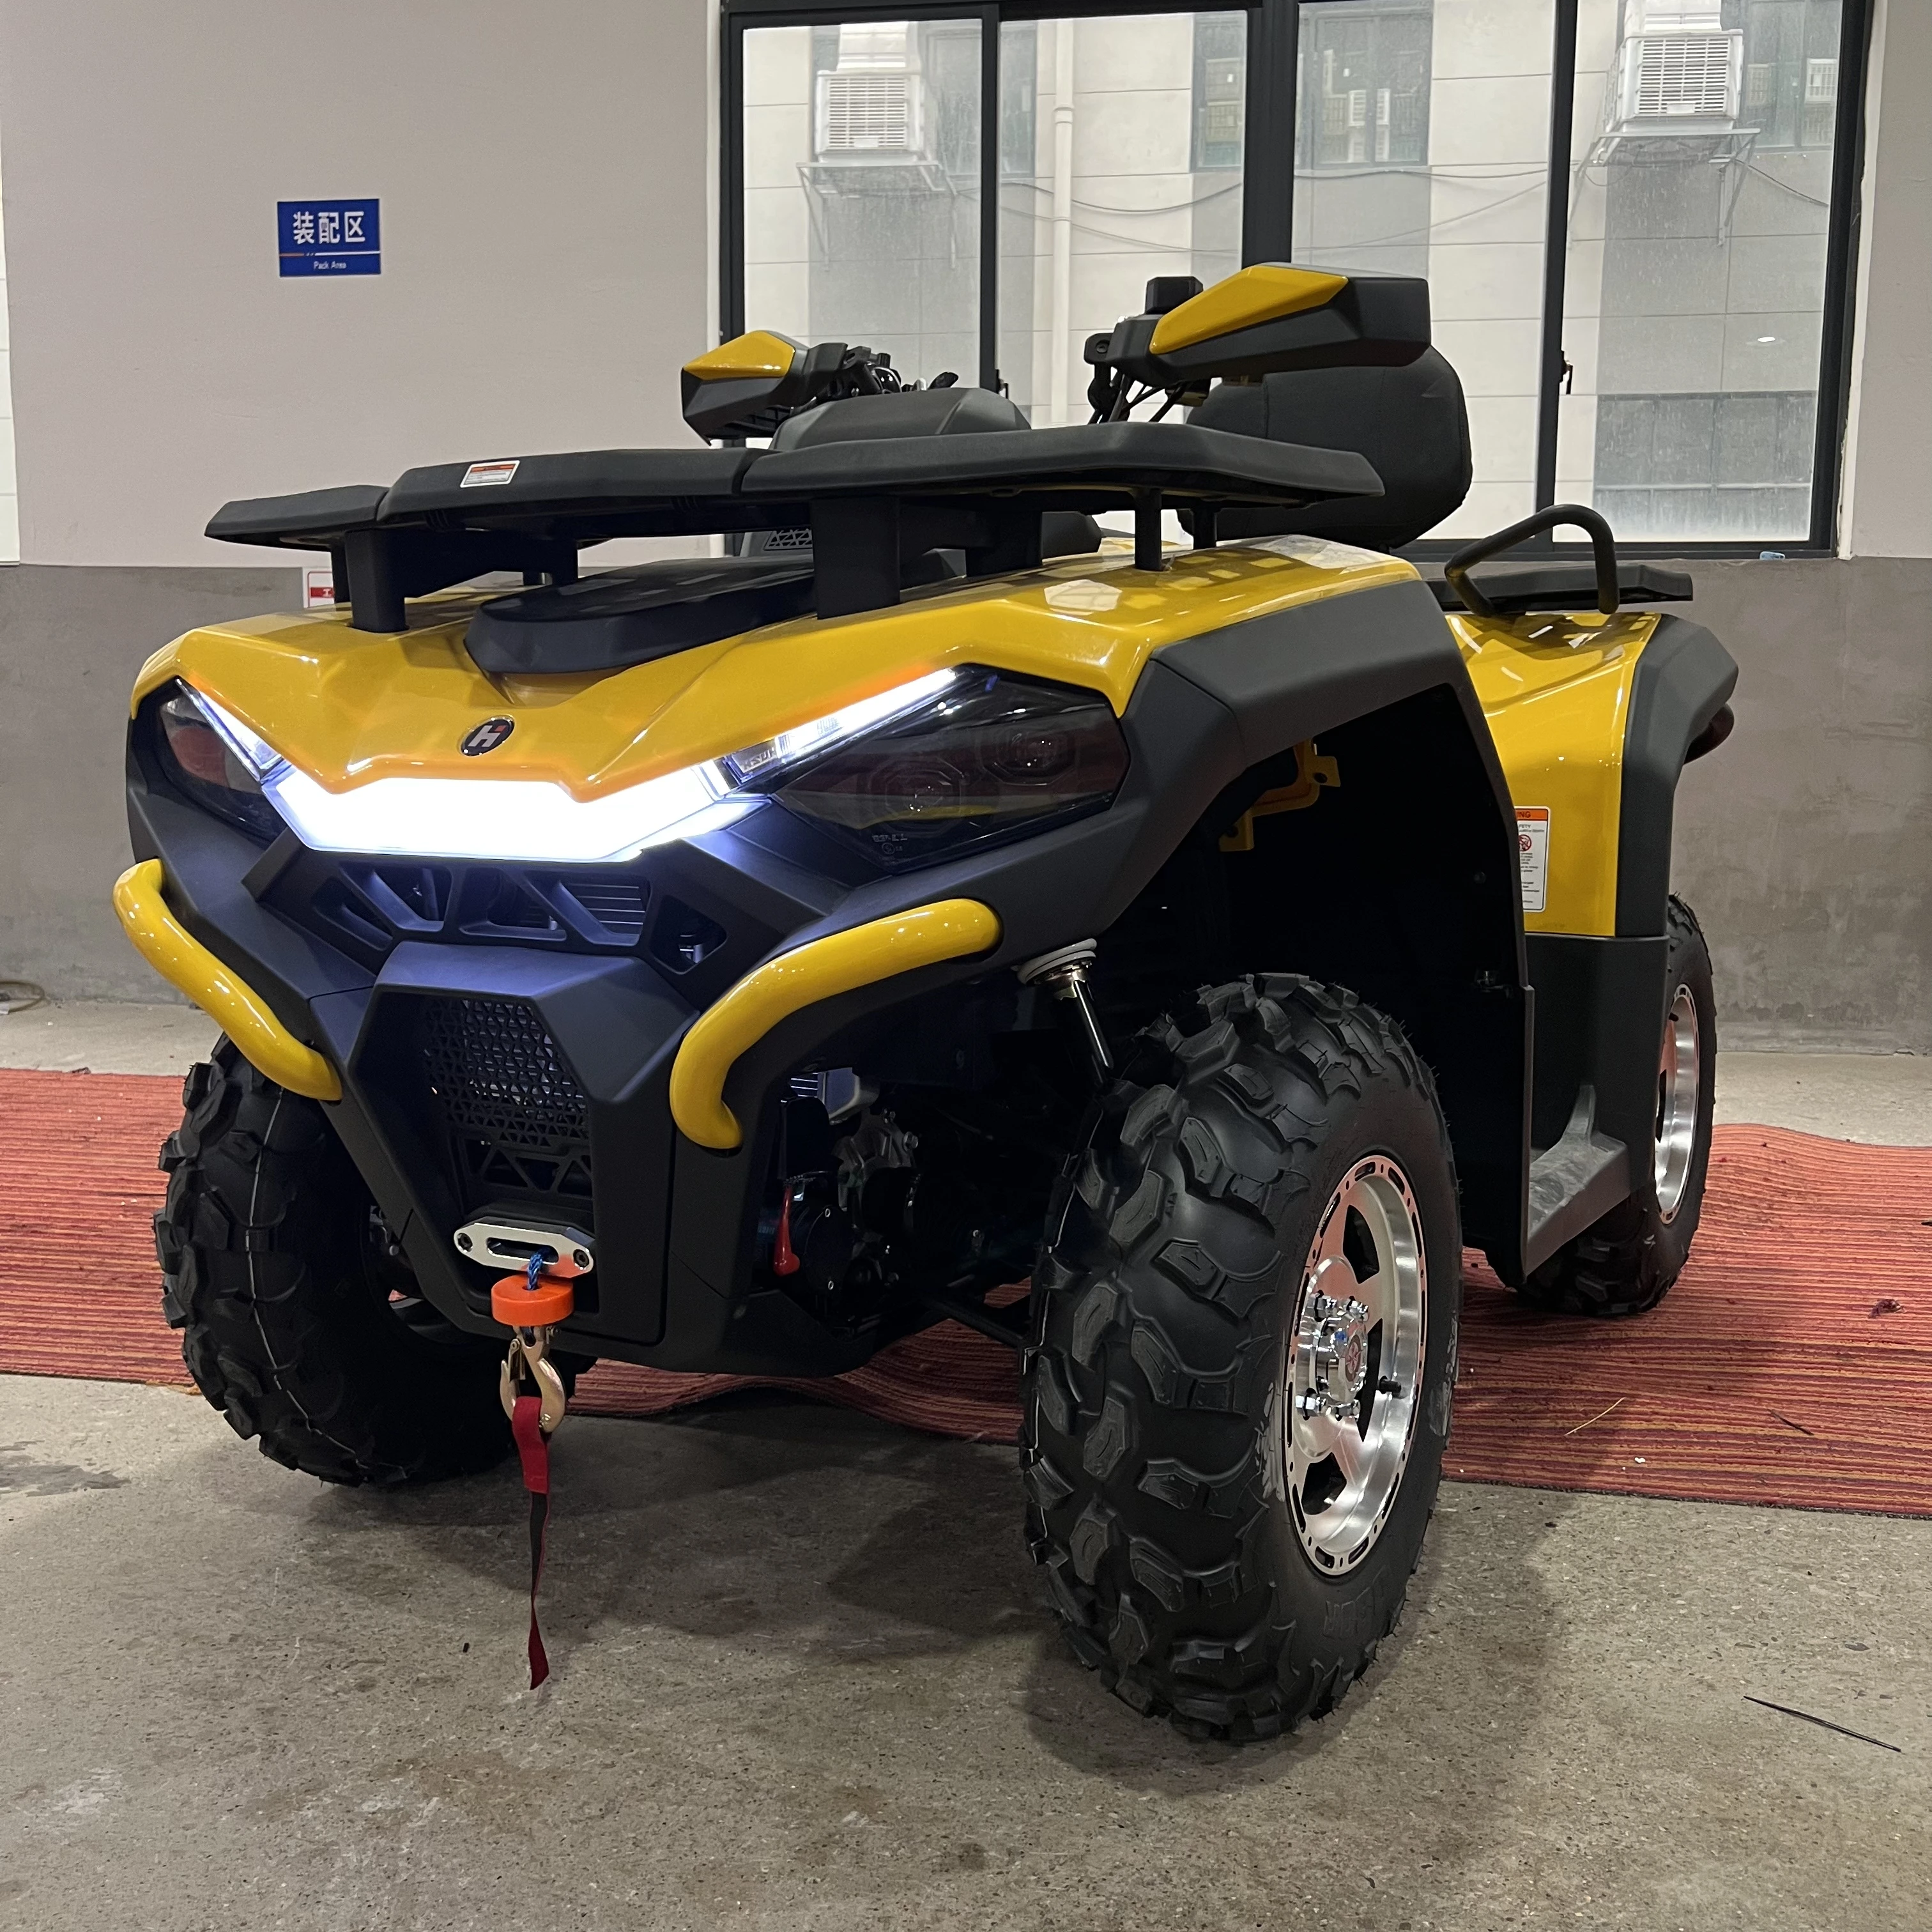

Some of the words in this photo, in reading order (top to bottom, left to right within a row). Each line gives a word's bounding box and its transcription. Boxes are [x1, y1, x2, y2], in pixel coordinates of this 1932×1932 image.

[293, 211, 365, 245] 装配区
[313, 261, 330, 270] Pack
[331, 261, 347, 269] Area
